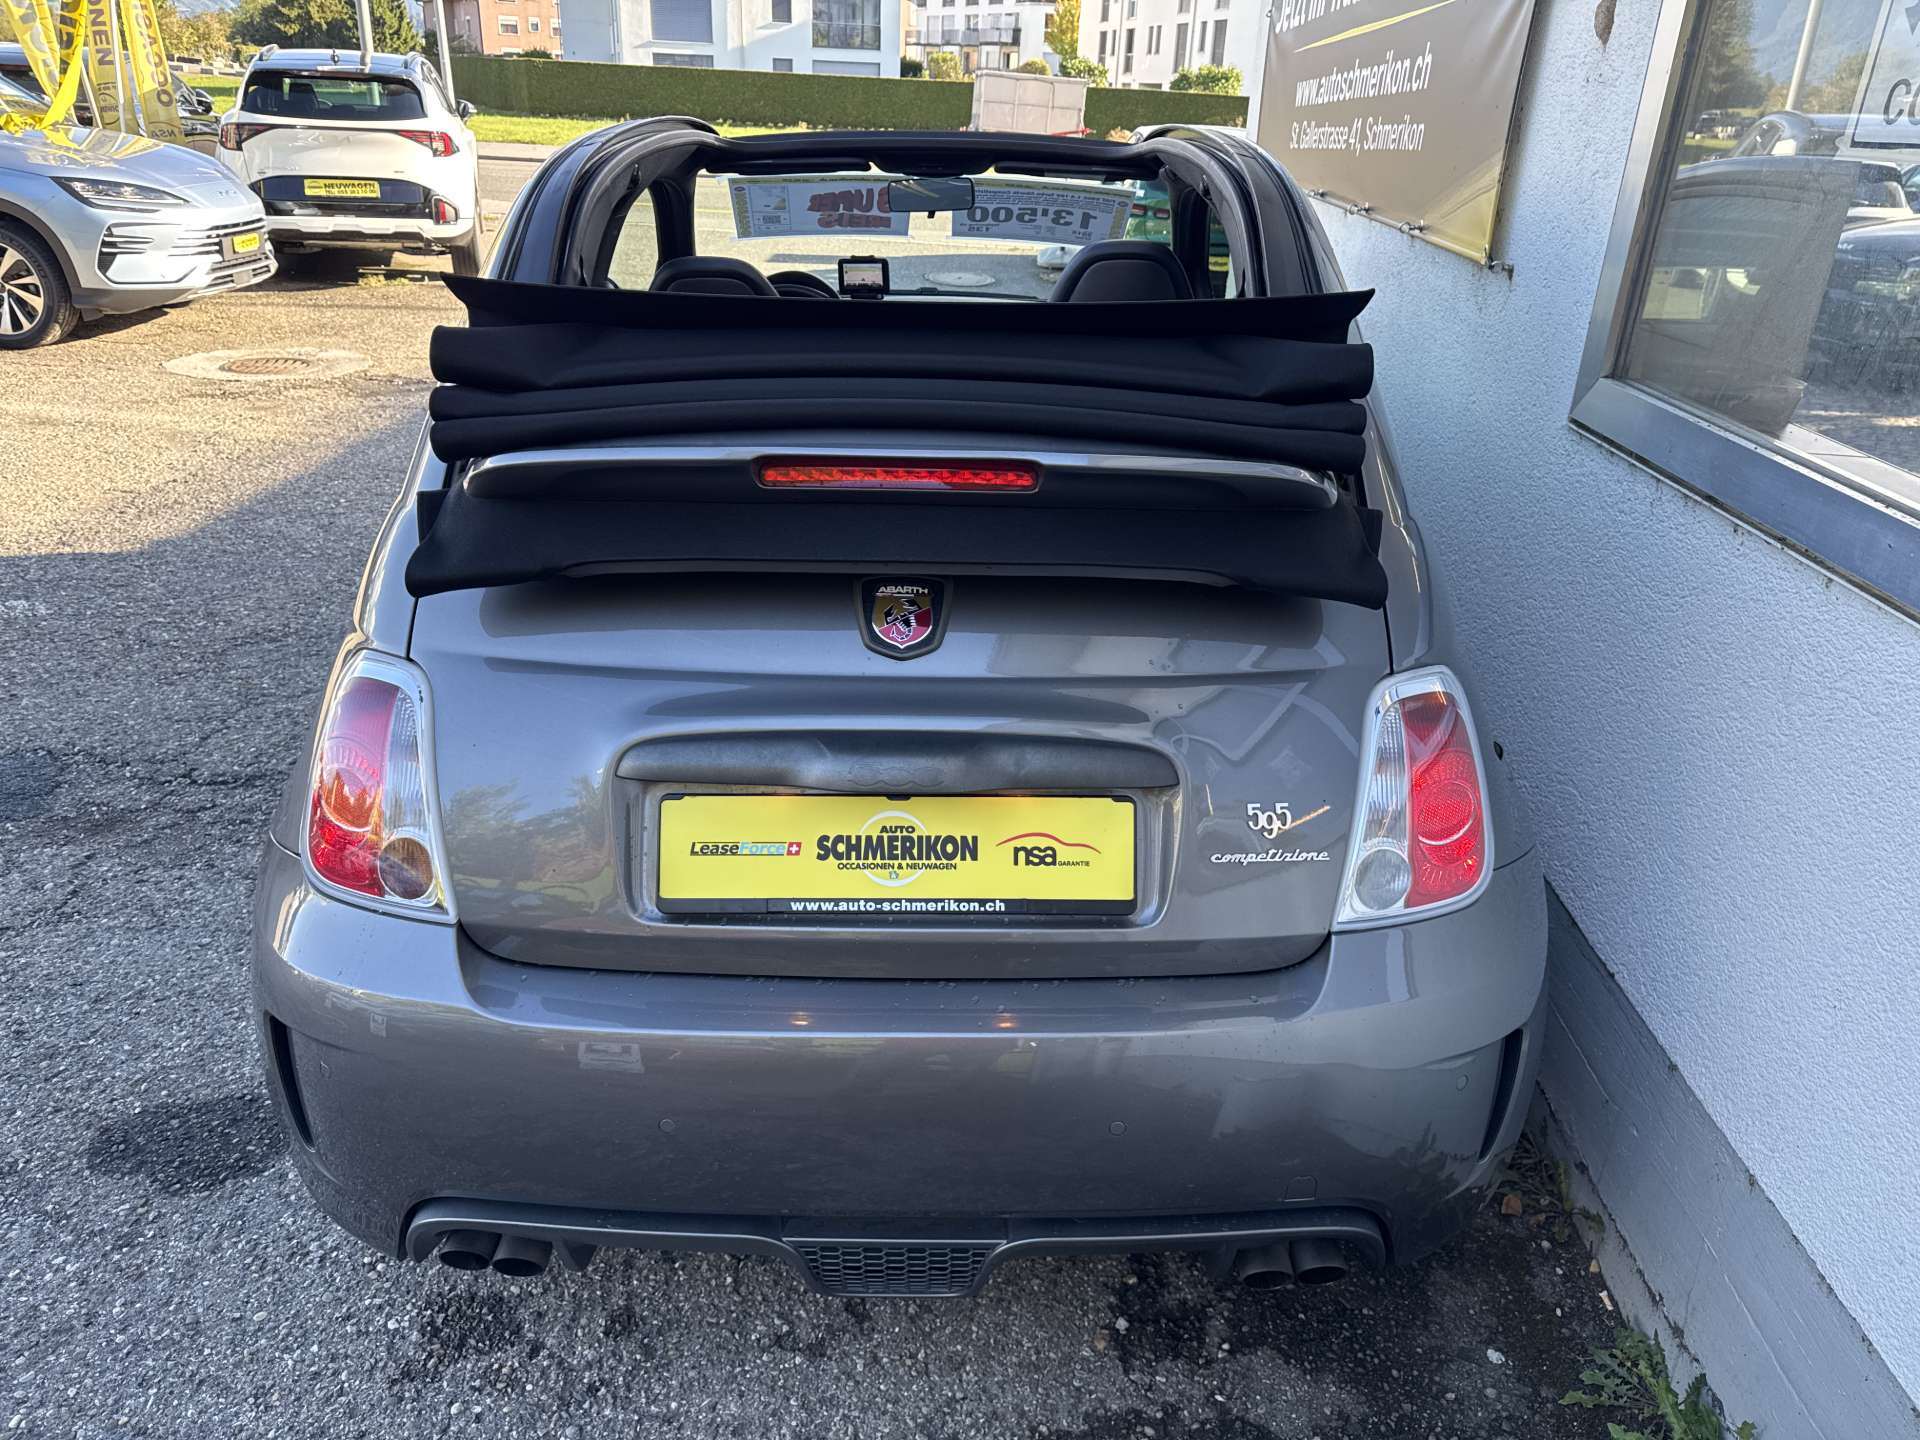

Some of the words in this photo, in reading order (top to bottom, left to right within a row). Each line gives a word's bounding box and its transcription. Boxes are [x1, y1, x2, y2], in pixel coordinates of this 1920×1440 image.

[1295, 41, 1432, 107] www.autoschmerikon.ch
[1300, 120, 1348, 150] Gallerstrasse
[1364, 114, 1425, 151] Schmerikon
[324, 182, 375, 190] NEUWAGEN
[878, 585, 929, 594] ABARTH
[1246, 802, 1292, 839] 595
[879, 825, 916, 834] AUTO
[690, 841, 787, 856] LeaseForce
[816, 834, 979, 862] SCHMERIKON
[1013, 845, 1057, 867] nsa
[1210, 849, 1331, 866] competizione
[837, 862, 895, 870] OCCASIONEN
[896, 862, 904, 870] &
[906, 862, 957, 870] NEUWAGEN
[790, 899, 1006, 912] www.auto-schmerikon.ch
